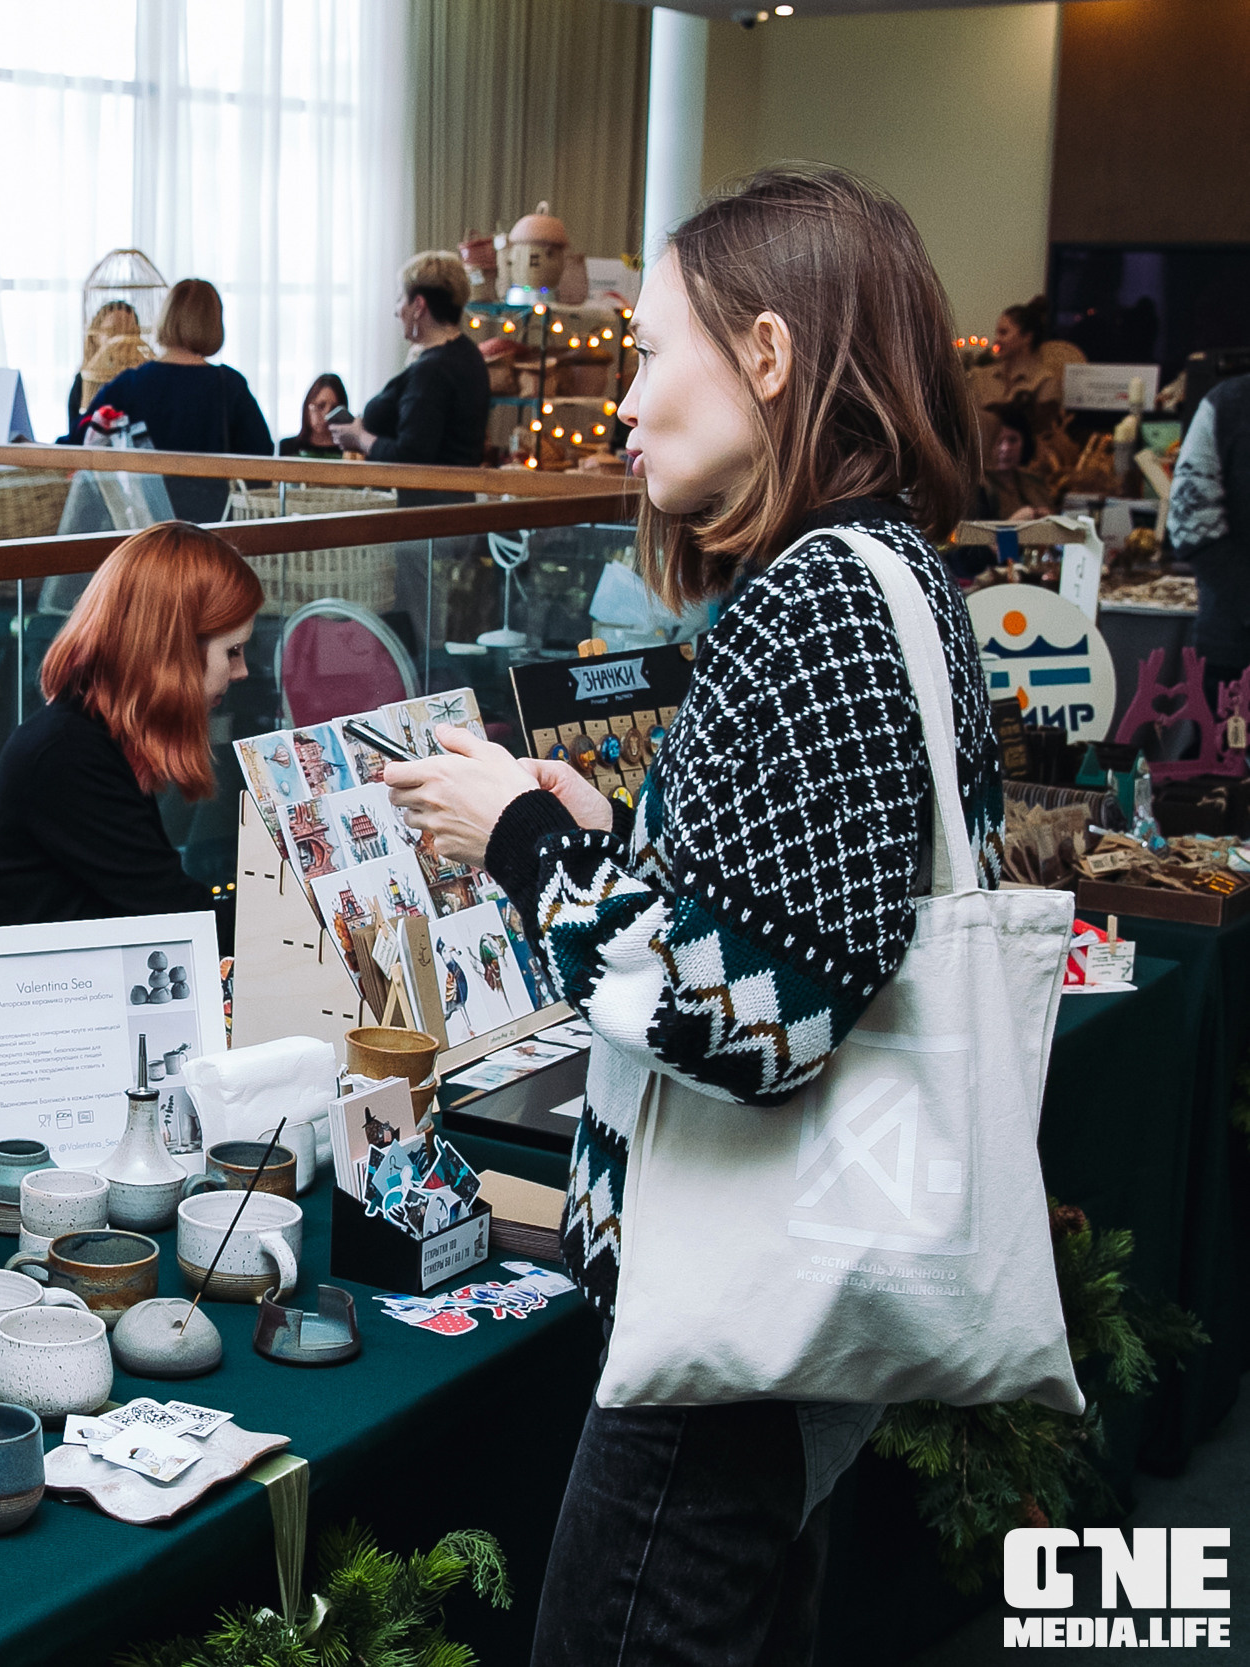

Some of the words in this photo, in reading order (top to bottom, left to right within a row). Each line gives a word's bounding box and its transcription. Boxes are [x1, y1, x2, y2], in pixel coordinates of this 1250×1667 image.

[583, 666, 636, 692] ЗНАЧКИ
[16, 981, 68, 994] Valentina
[71, 978, 93, 990] Sea
[32, 997, 64, 1007] керамика
[64, 994, 88, 1004] ручной
[89, 991, 114, 1002] работы
[424, 1242, 448, 1262] ОТКРЫТКИ
[423, 1259, 444, 1277] СТИКЕРЫ
[811, 1254, 885, 1275] ФЕСТИВАЛЬ
[887, 1265, 957, 1281] УЛИЧНОГО
[796, 1269, 867, 1289] ИСКУССТВА
